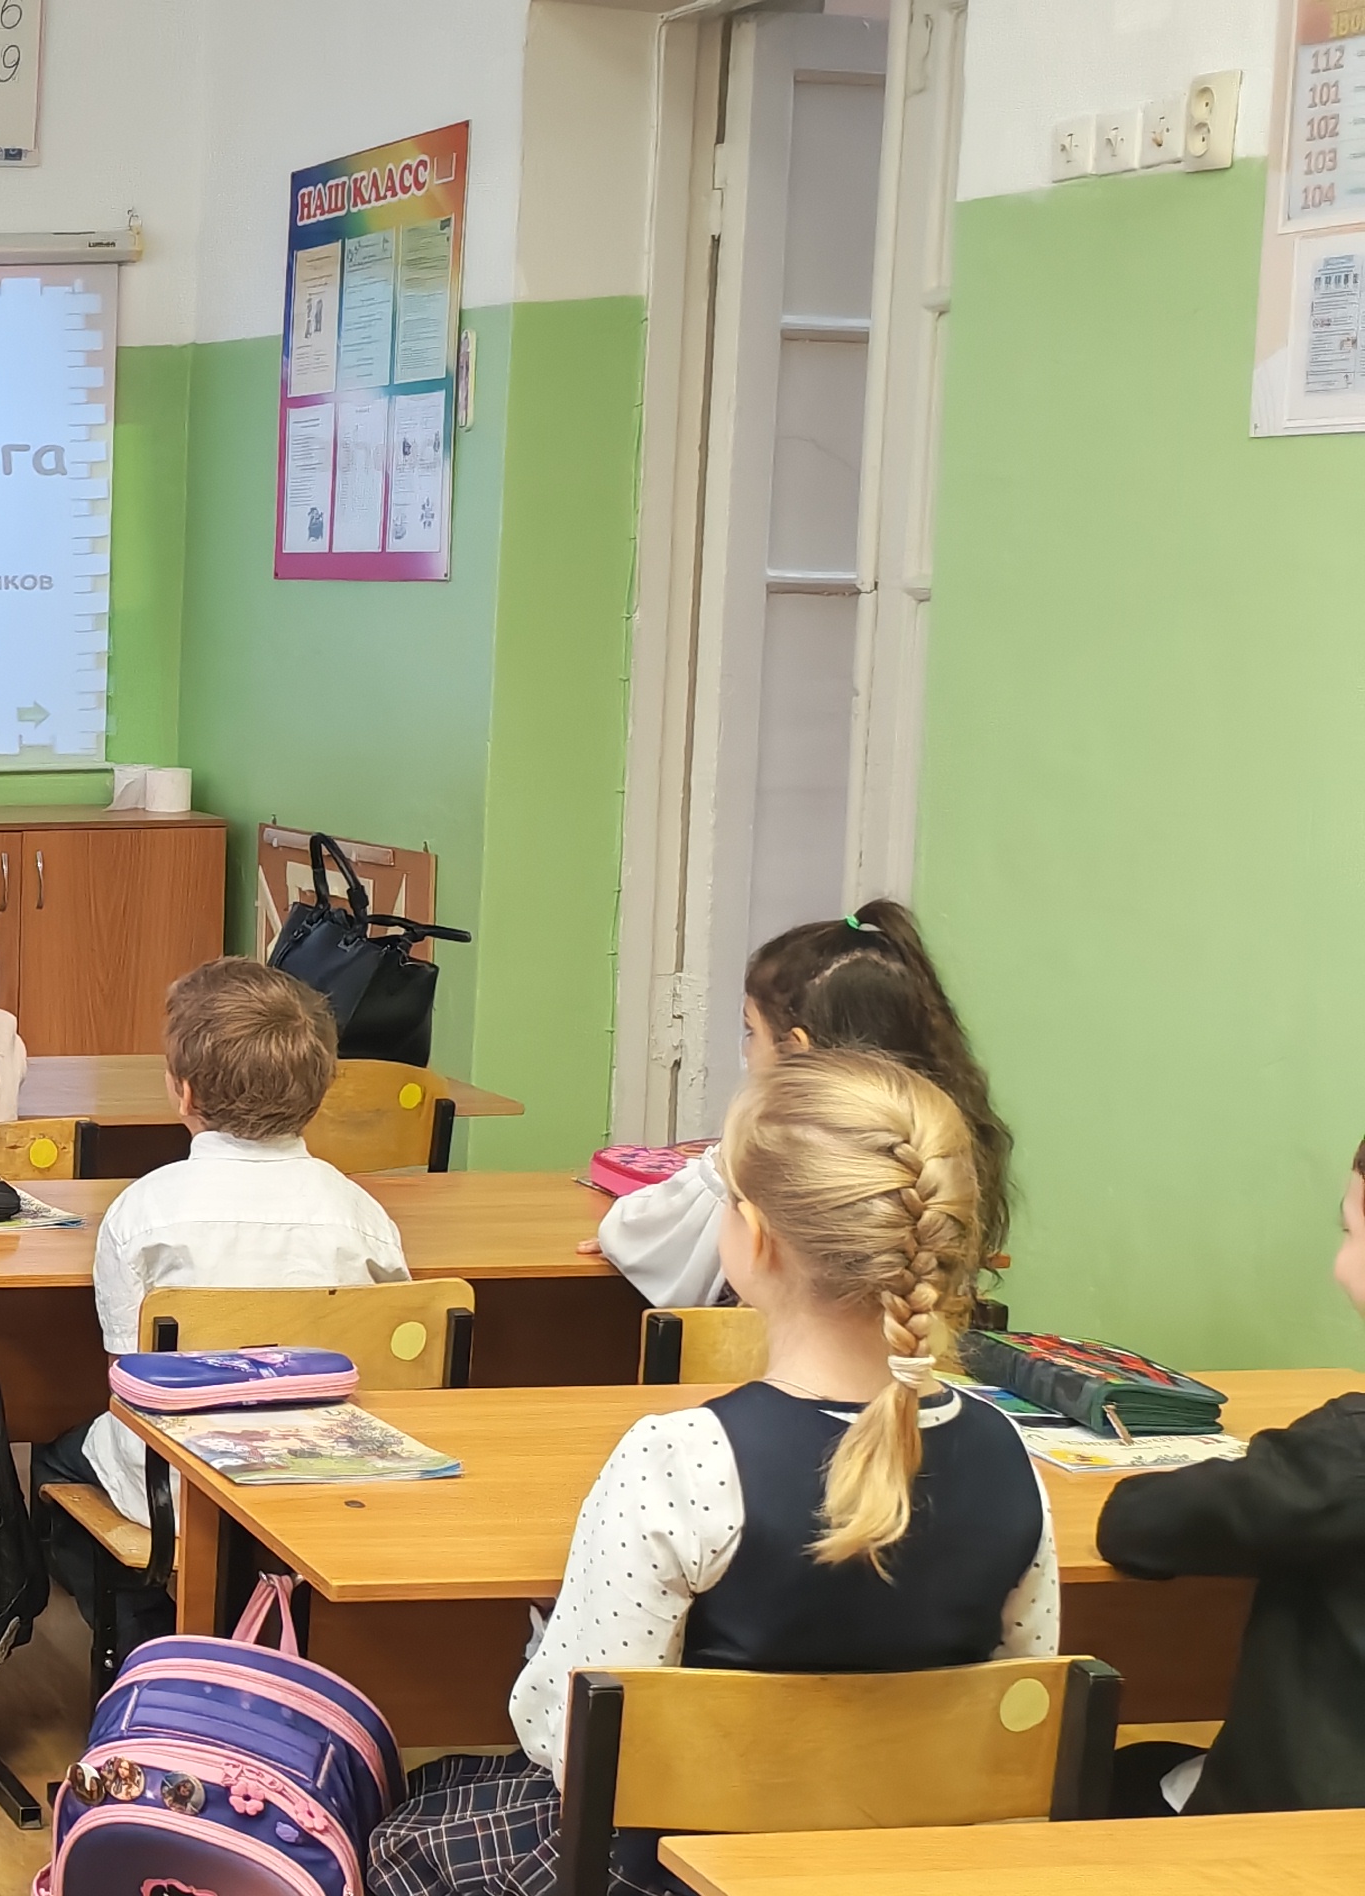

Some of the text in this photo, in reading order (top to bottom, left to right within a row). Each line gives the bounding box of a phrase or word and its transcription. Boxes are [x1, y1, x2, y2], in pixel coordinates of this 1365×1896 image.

[1310, 45, 1345, 74] 112
[1307, 80, 1341, 109] 101
[1305, 113, 1340, 142] 102
[1303, 148, 1338, 176] 103
[297, 158, 429, 223] НАШ КЛАСС
[1301, 182, 1336, 211] 104
